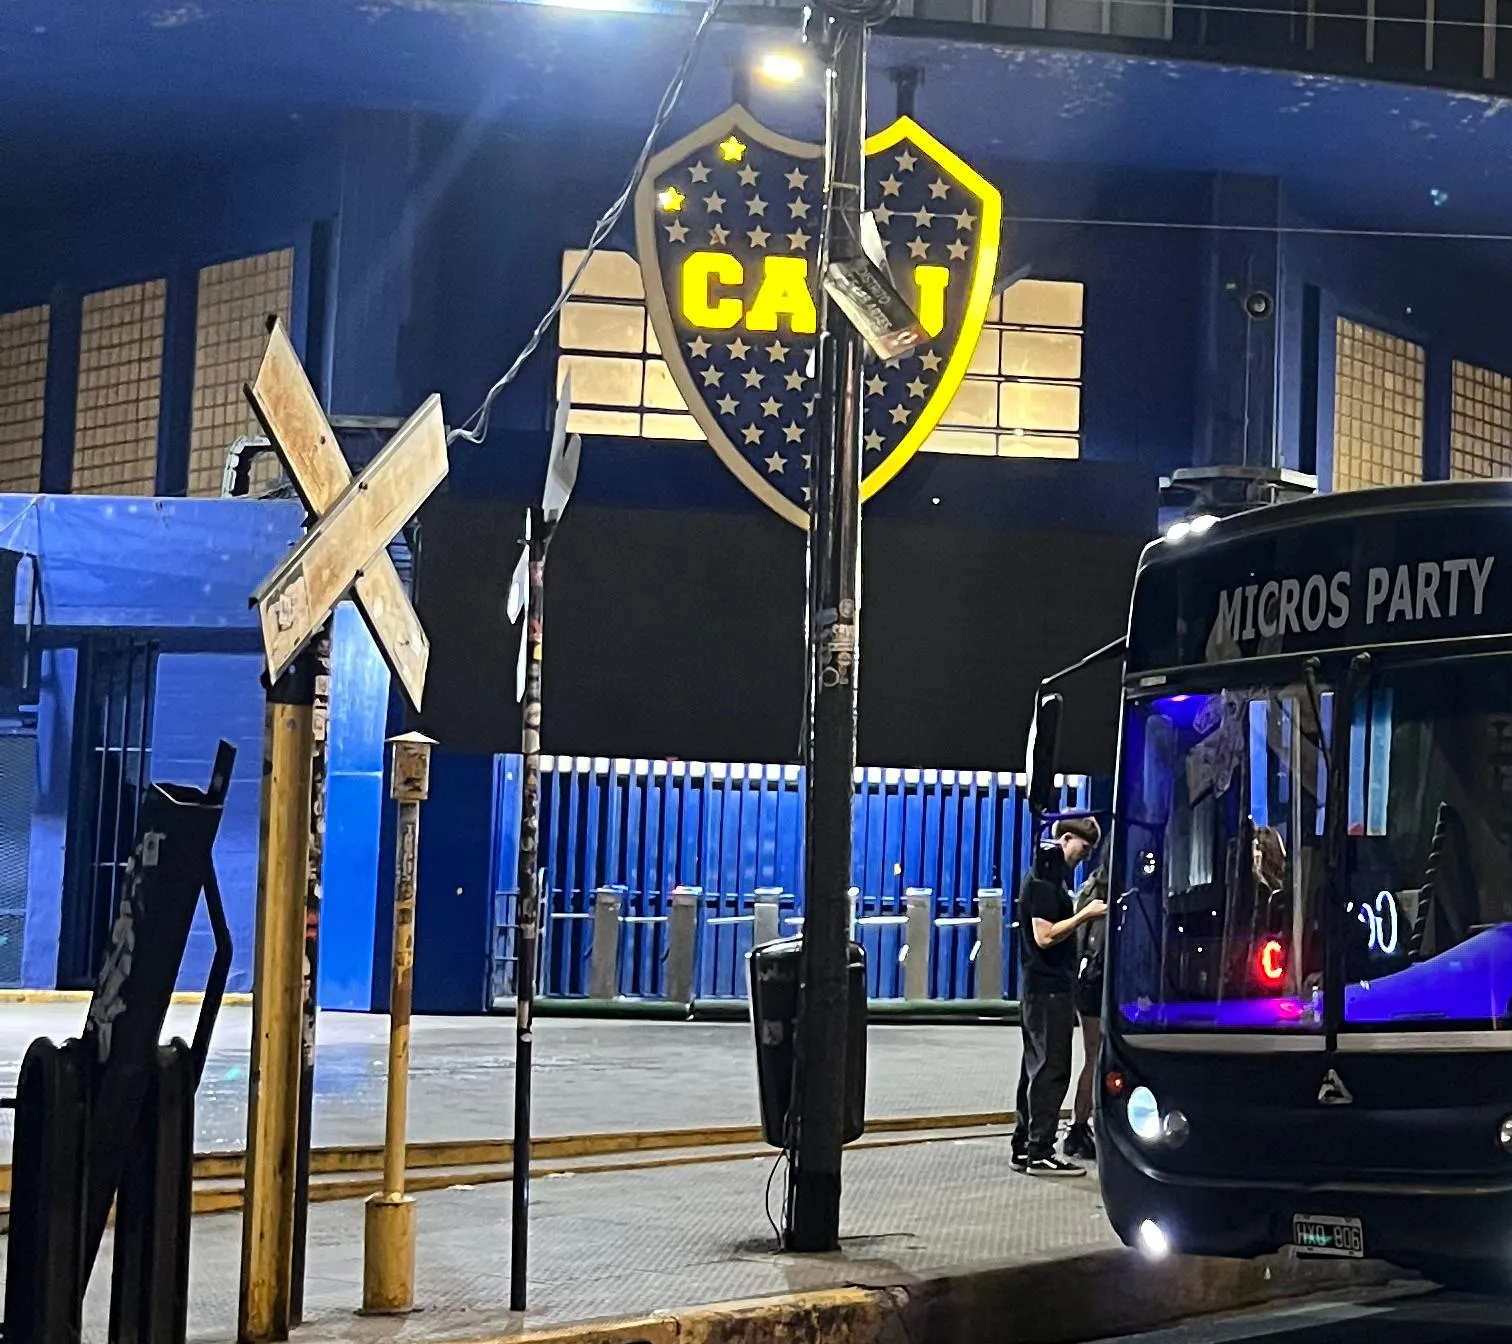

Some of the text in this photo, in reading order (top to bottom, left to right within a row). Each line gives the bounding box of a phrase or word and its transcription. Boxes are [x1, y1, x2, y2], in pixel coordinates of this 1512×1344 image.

[681, 251, 949, 337] CAJ
[1215, 556, 1495, 644] MICROS PARTY
[1333, 1226, 1361, 1250] 806
